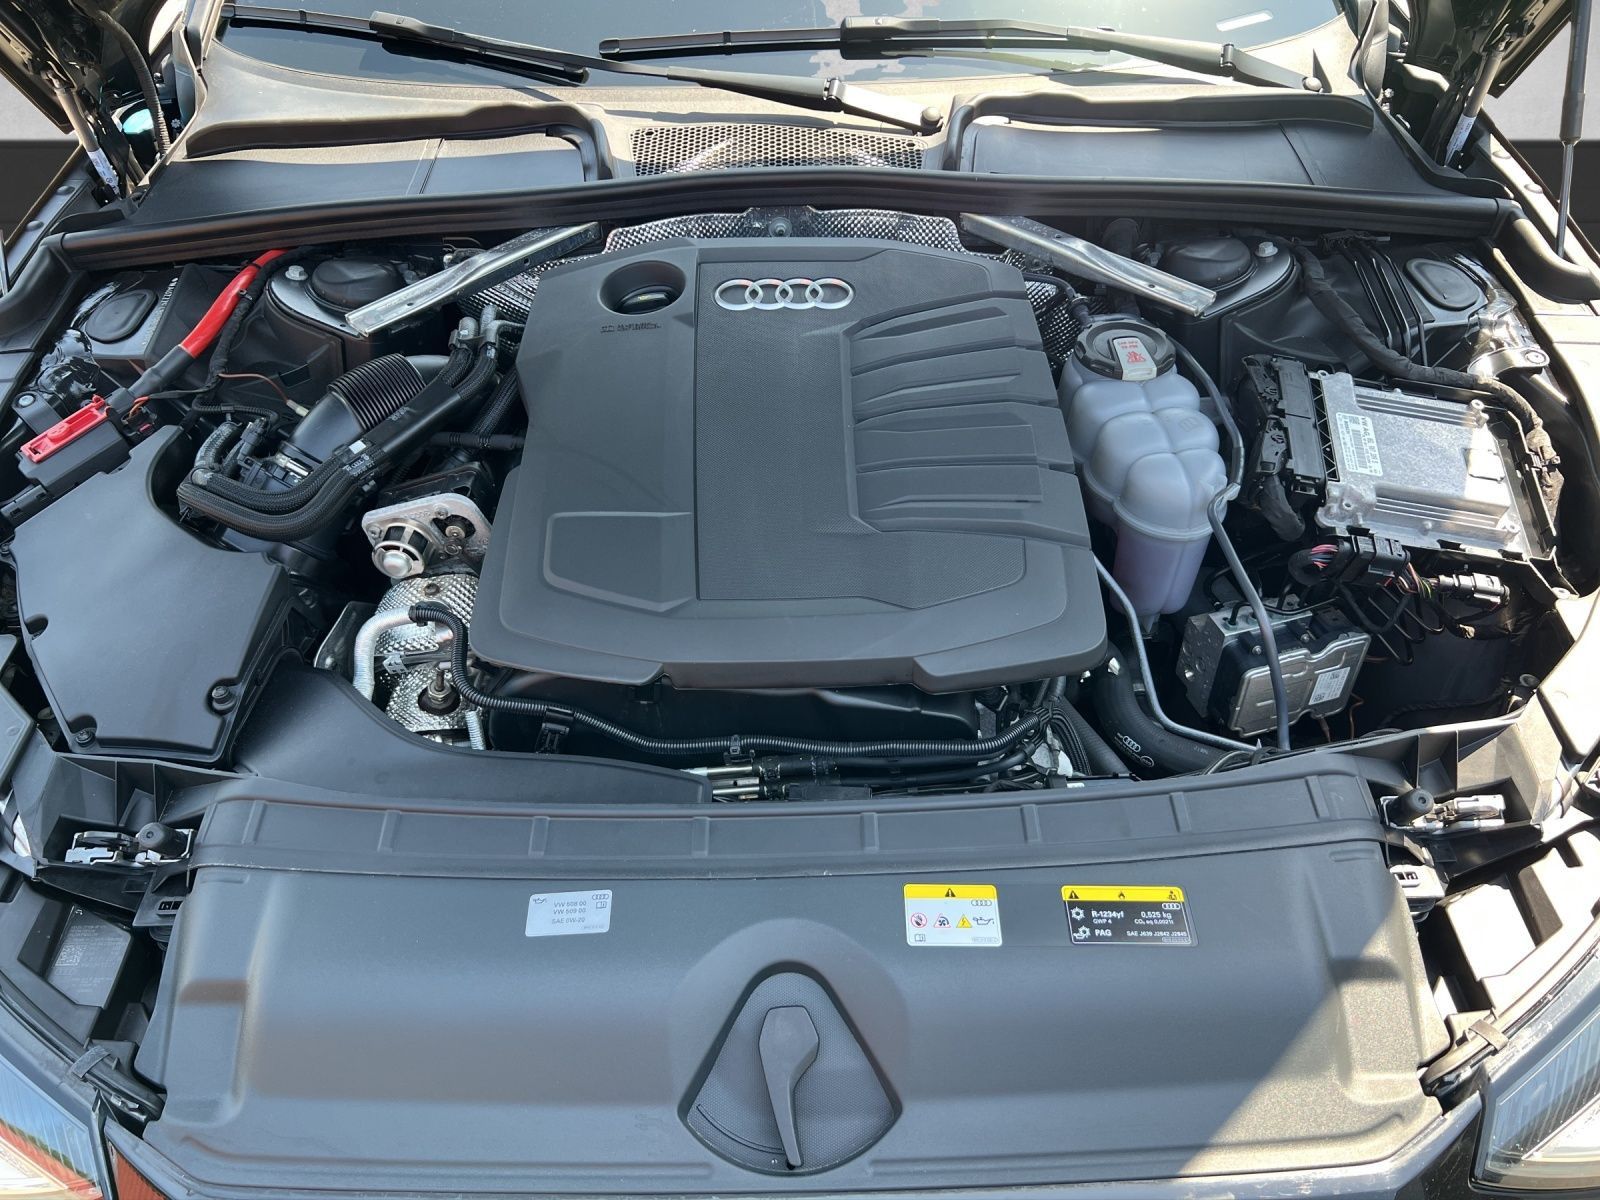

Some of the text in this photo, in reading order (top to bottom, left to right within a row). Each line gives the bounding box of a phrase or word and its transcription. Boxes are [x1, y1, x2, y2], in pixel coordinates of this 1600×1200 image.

[1091, 910, 1124, 918] R-1234yf
[1162, 911, 1172, 919] kg
[1094, 928, 1112, 937] PAG
